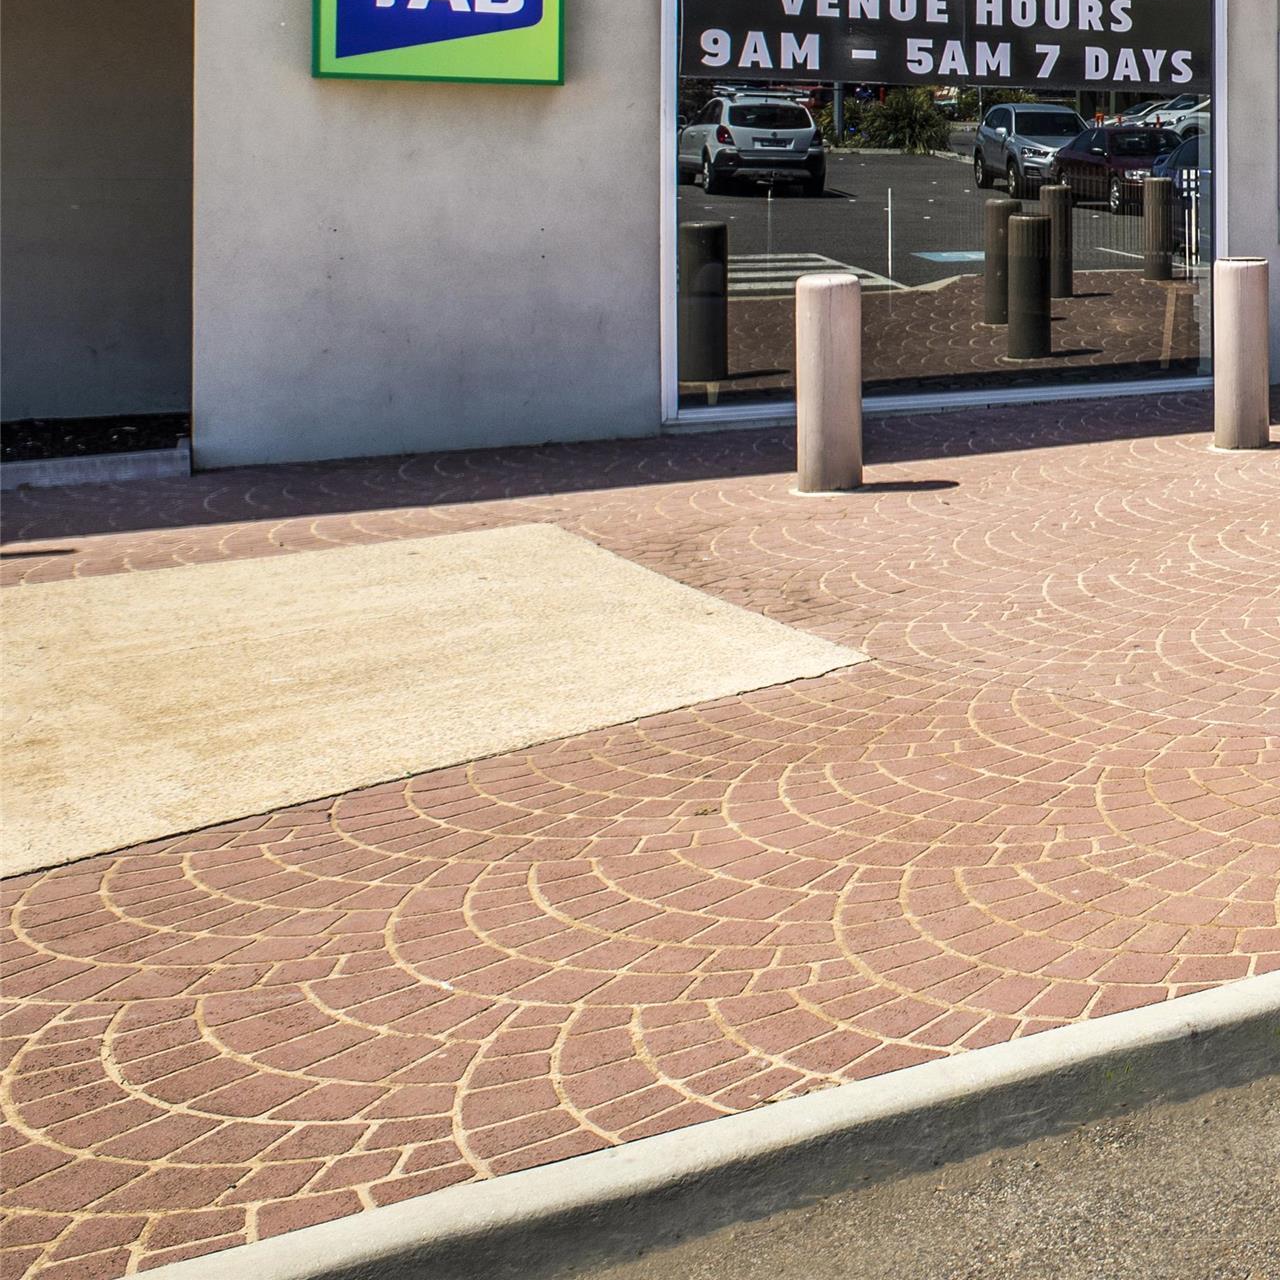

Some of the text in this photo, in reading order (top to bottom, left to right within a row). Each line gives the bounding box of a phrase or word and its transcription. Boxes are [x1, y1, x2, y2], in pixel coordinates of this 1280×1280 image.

[700, 28, 1194, 83] 9AM - 5AM 7 DAYS
